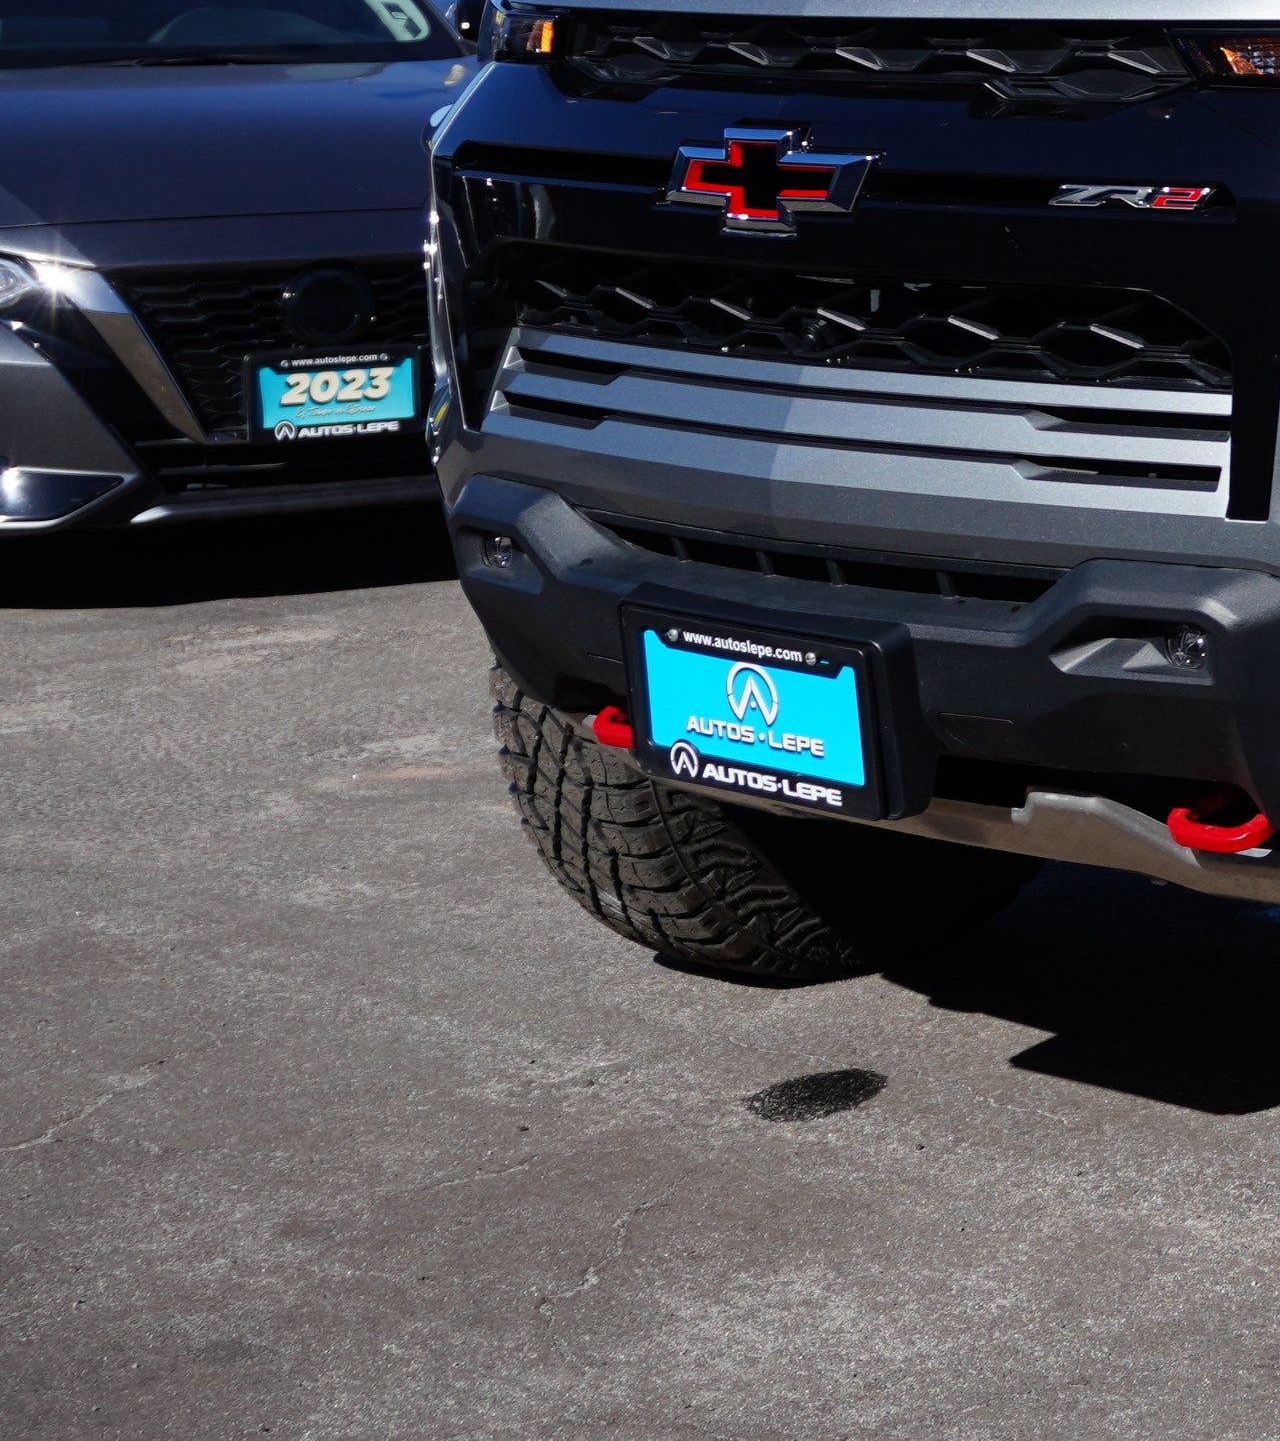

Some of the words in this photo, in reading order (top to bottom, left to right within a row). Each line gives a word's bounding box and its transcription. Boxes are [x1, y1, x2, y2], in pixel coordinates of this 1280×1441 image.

[1049, 184, 1211, 210] ZR2
[291, 354, 378, 366] www.autoslepe.com
[279, 367, 394, 406] 2023
[683, 630, 803, 663] www.autoslepe.com
